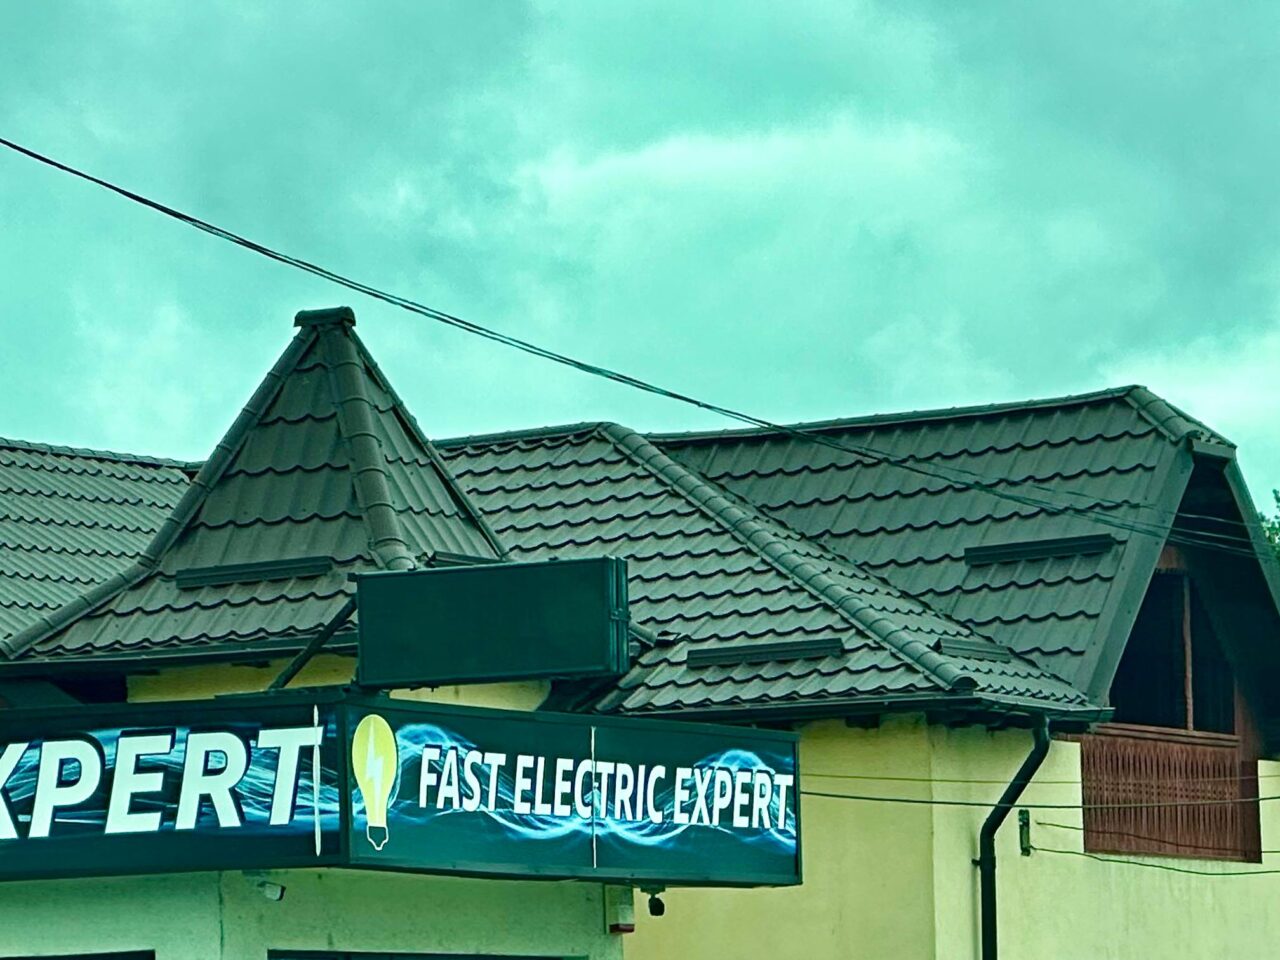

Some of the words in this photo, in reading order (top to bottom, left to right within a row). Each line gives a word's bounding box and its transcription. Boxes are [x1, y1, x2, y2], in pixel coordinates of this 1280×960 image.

[0, 726, 324, 839] XPERT
[419, 746, 506, 812] FAST
[514, 755, 666, 824] ELECTRIC
[673, 767, 794, 830] EXPERT
